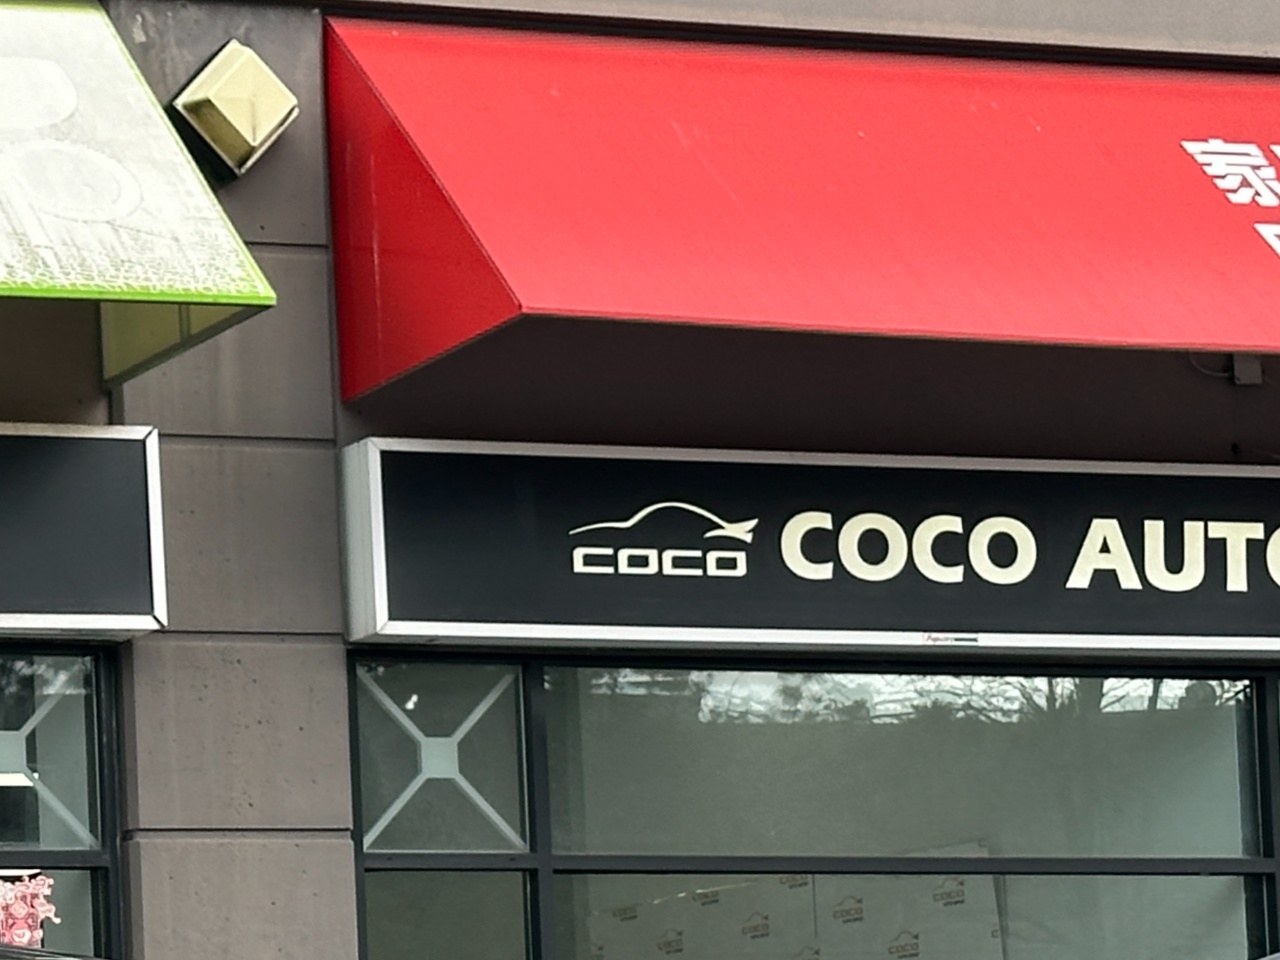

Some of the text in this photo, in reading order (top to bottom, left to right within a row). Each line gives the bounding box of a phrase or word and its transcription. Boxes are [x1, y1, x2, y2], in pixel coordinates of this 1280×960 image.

[1180, 138, 1280, 207] 家
[572, 546, 747, 577] COCO
[780, 511, 1280, 593] COCO AUT
